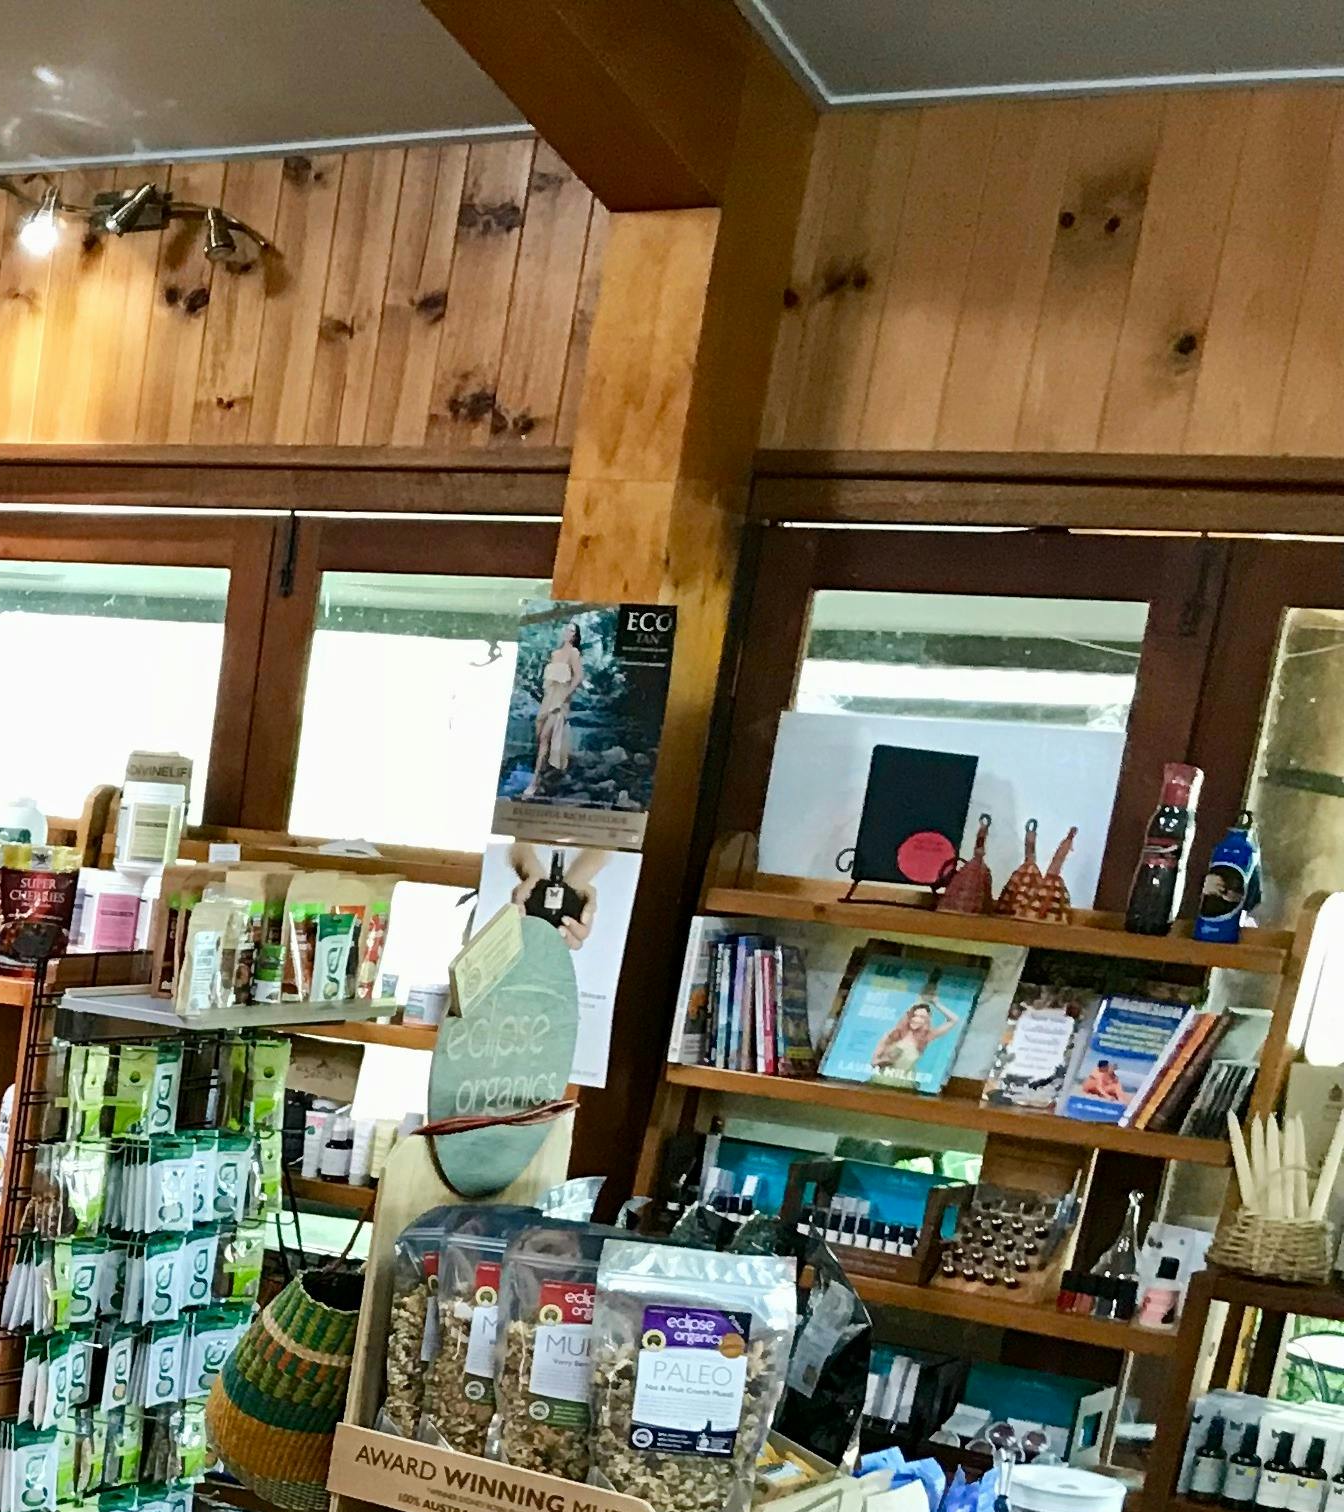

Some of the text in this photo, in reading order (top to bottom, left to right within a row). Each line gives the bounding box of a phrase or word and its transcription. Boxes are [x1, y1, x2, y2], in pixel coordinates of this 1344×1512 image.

[627, 611, 673, 632] ECO
[20, 878, 57, 889] SUPER
[9, 890, 65, 904] CHERRIES
[667, 1313, 716, 1332] eclipse
[653, 1360, 733, 1386] PALEO
[355, 1445, 436, 1482] AWARD
